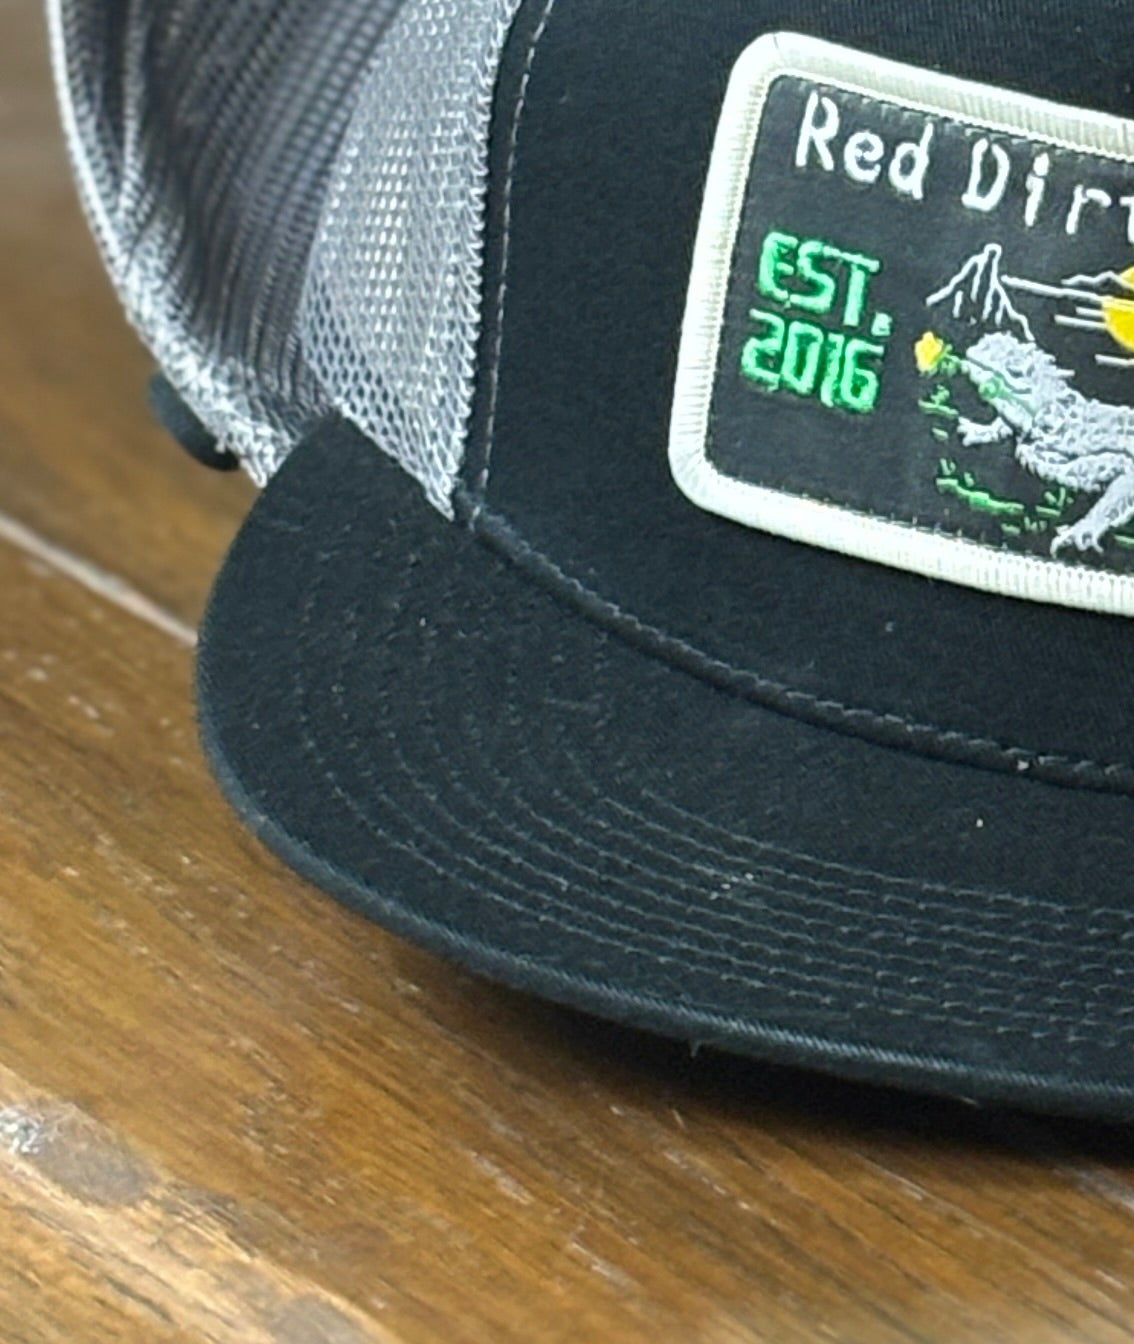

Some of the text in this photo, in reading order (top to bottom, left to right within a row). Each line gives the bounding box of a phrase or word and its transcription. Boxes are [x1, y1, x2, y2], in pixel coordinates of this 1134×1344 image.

[795, 90, 934, 201] Red
[758, 230, 893, 337] EST.
[740, 308, 885, 414] 2016
